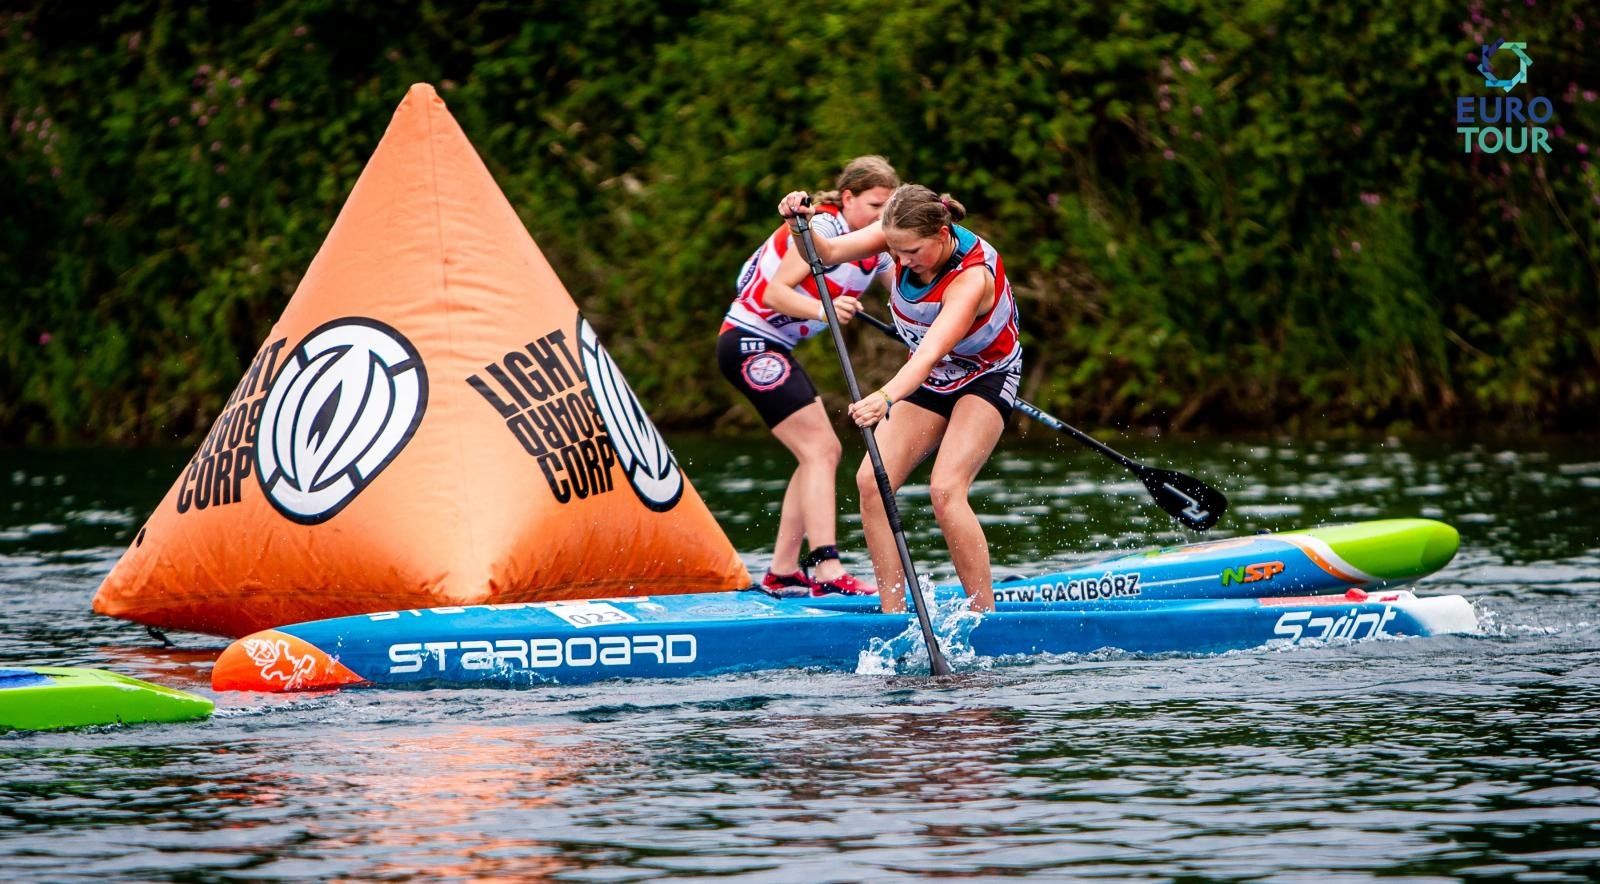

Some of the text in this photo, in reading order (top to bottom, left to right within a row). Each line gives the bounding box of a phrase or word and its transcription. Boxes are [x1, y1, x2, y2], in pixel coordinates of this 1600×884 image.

[465, 328, 588, 419] LIGHT
[176, 445, 253, 515] CORP
[536, 434, 616, 504] CORP
[1041, 573, 1141, 602] RACIBÓRZ
[1221, 560, 1286, 586] NSP
[568, 610, 629, 626] 023
[1273, 605, 1397, 646] Sprint
